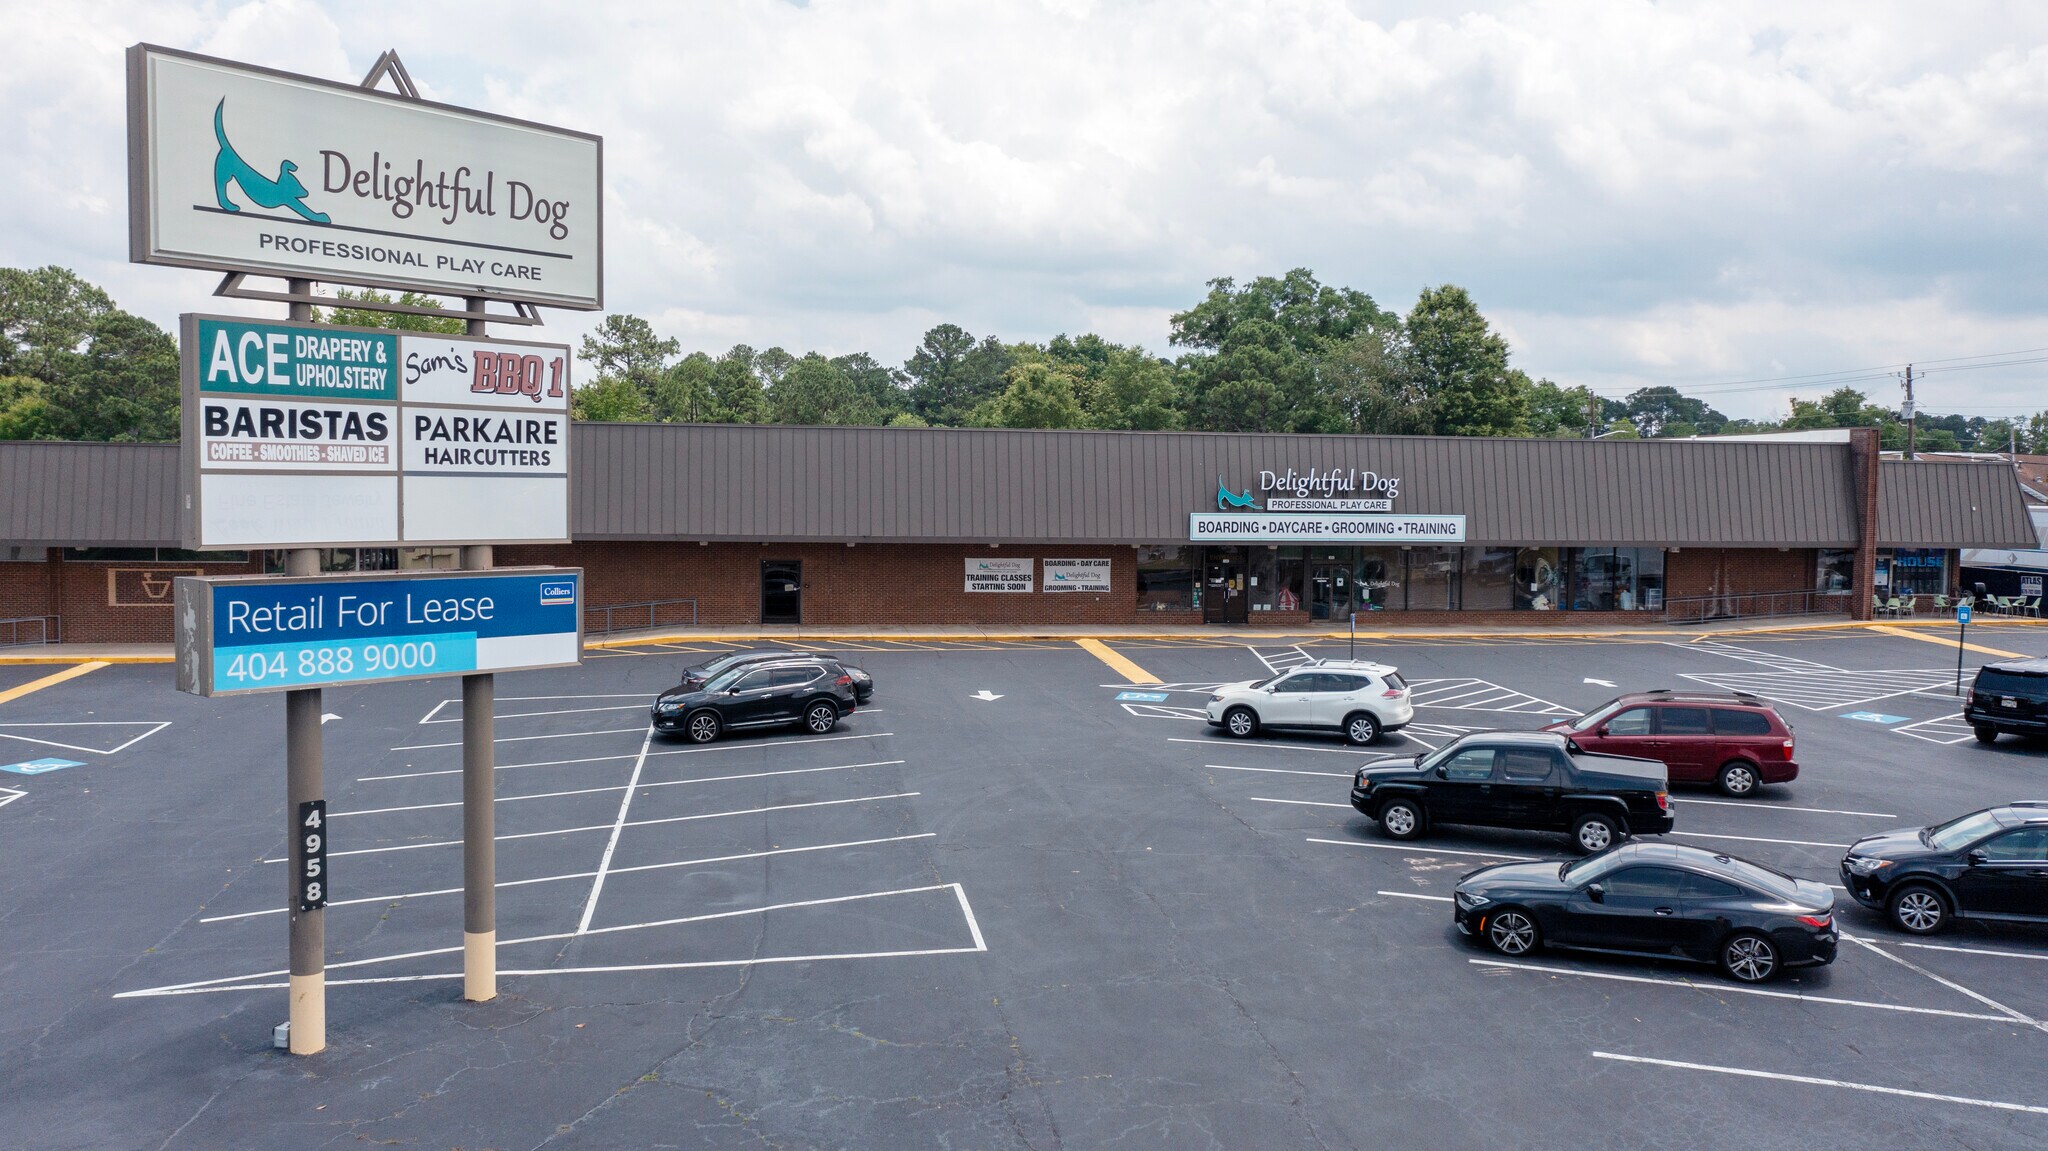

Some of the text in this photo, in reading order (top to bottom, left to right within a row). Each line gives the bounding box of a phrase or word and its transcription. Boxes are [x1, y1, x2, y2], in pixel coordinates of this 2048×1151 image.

[319, 150, 570, 241] Delightful Dog
[259, 233, 543, 281] PROFESSIONAL PLAY CARE
[207, 329, 291, 386] ACE
[295, 335, 387, 365] DRAPERY &
[296, 362, 388, 391] UPHOLSTERY
[406, 347, 469, 385] Sam's
[470, 350, 564, 403] BBQ 1
[204, 405, 389, 442] BARISTAS
[415, 415, 558, 445] PARKAIRE
[211, 443, 385, 463] COFFEE SMOOTHIES SHAVED ICE
[424, 447, 551, 467] HAIRCUTTERS
[1259, 468, 1400, 498] Delightful Dog
[1271, 500, 1388, 510] PROFESSIONAL PLAY CARE
[1198, 521, 1456, 535] BOARDING DAYCARE GROOMING TRAINING
[1897, 556, 1944, 567] HOUSE
[544, 587, 571, 596] Colliers
[966, 574, 1032, 582] TRAINING CLASSES
[228, 593, 495, 634] Retail For Lease
[226, 641, 436, 681] 404 888 9000
[305, 809, 322, 901] 4958
